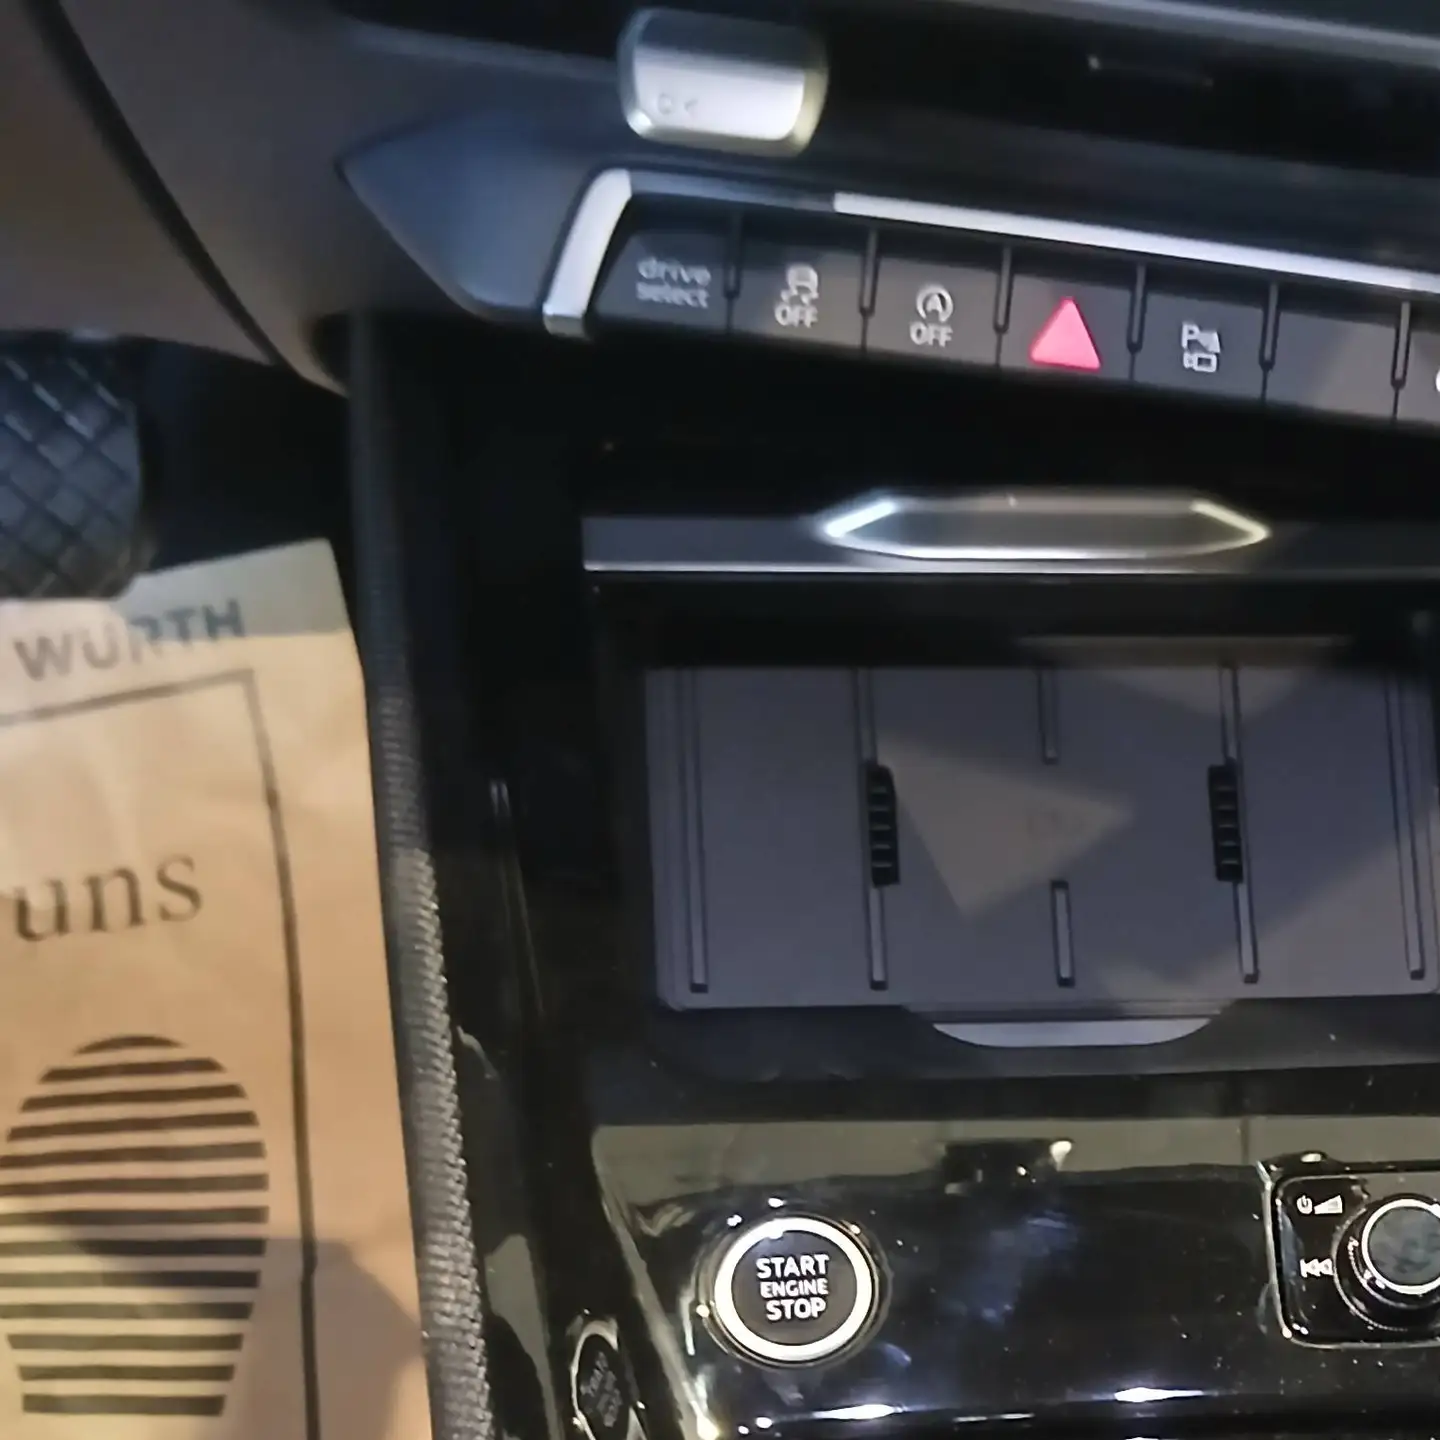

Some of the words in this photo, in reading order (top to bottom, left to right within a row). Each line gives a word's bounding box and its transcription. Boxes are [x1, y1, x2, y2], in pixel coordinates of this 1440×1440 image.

[774, 302, 819, 329] OFF
[909, 321, 954, 348] OFF
[756, 1254, 830, 1279] START
[760, 1278, 829, 1298] ENGINE
[766, 1297, 827, 1321] STOP
